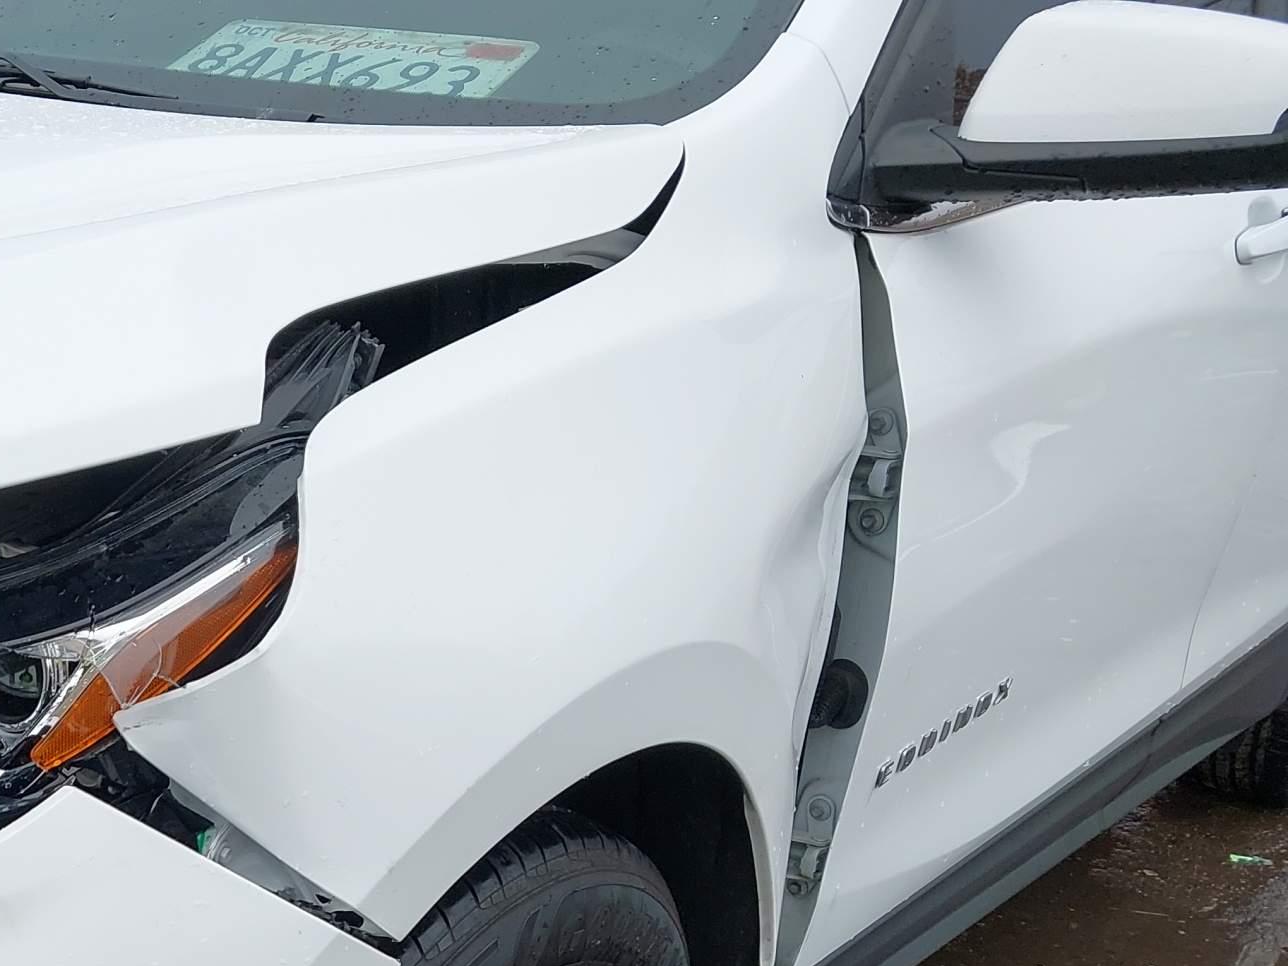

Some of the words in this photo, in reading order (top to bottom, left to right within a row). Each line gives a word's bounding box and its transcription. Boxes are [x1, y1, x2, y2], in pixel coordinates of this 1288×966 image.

[234, 24, 275, 37] OCT
[273, 28, 464, 57] California
[188, 43, 481, 97] 8AXX693
[874, 676, 1014, 788] EQUINOX
